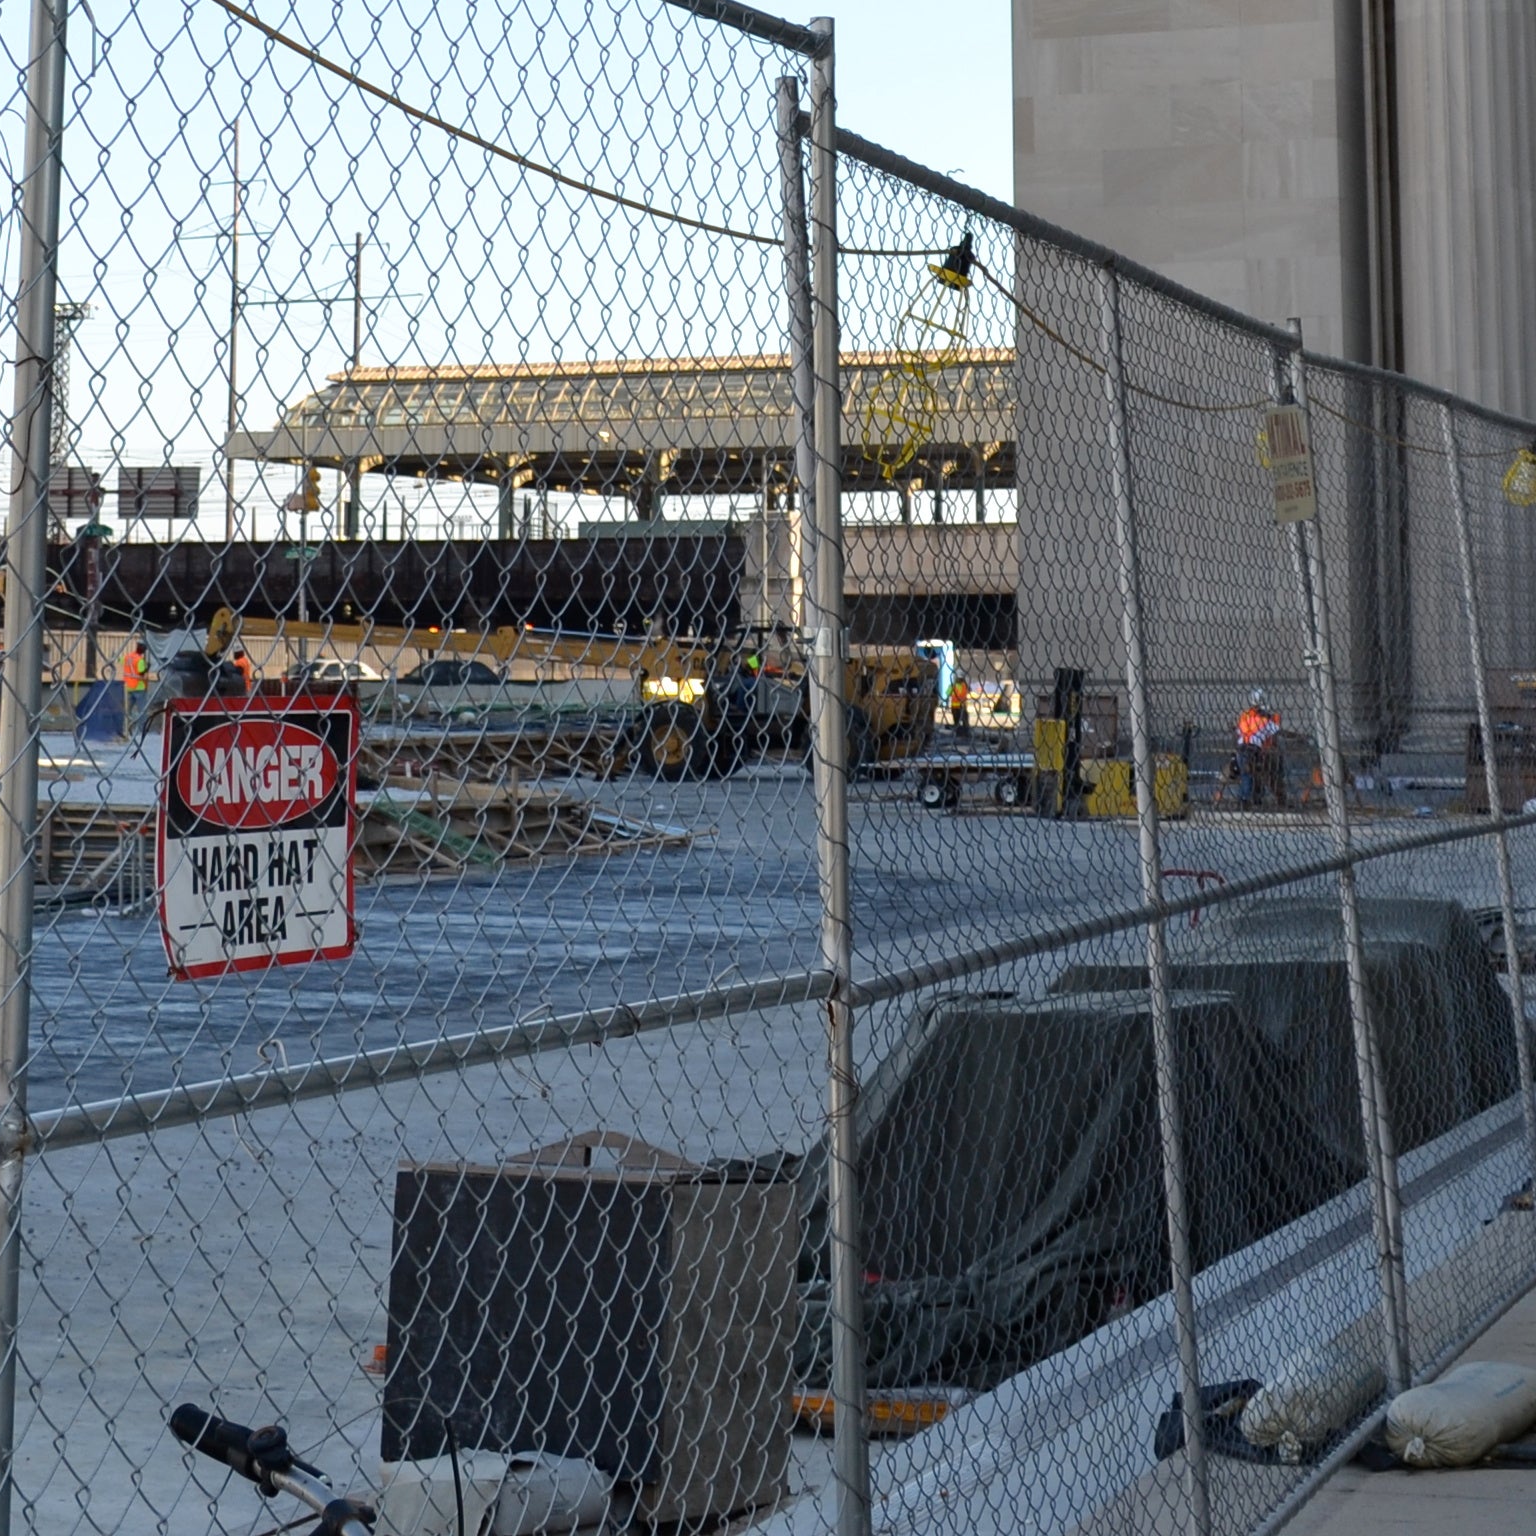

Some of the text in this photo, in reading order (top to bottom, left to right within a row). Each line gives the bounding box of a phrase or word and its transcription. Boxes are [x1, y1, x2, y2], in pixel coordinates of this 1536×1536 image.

[189, 744, 324, 807] DANGER
[192, 838, 319, 895] HARD HAT
[221, 895, 288, 948] AREA
